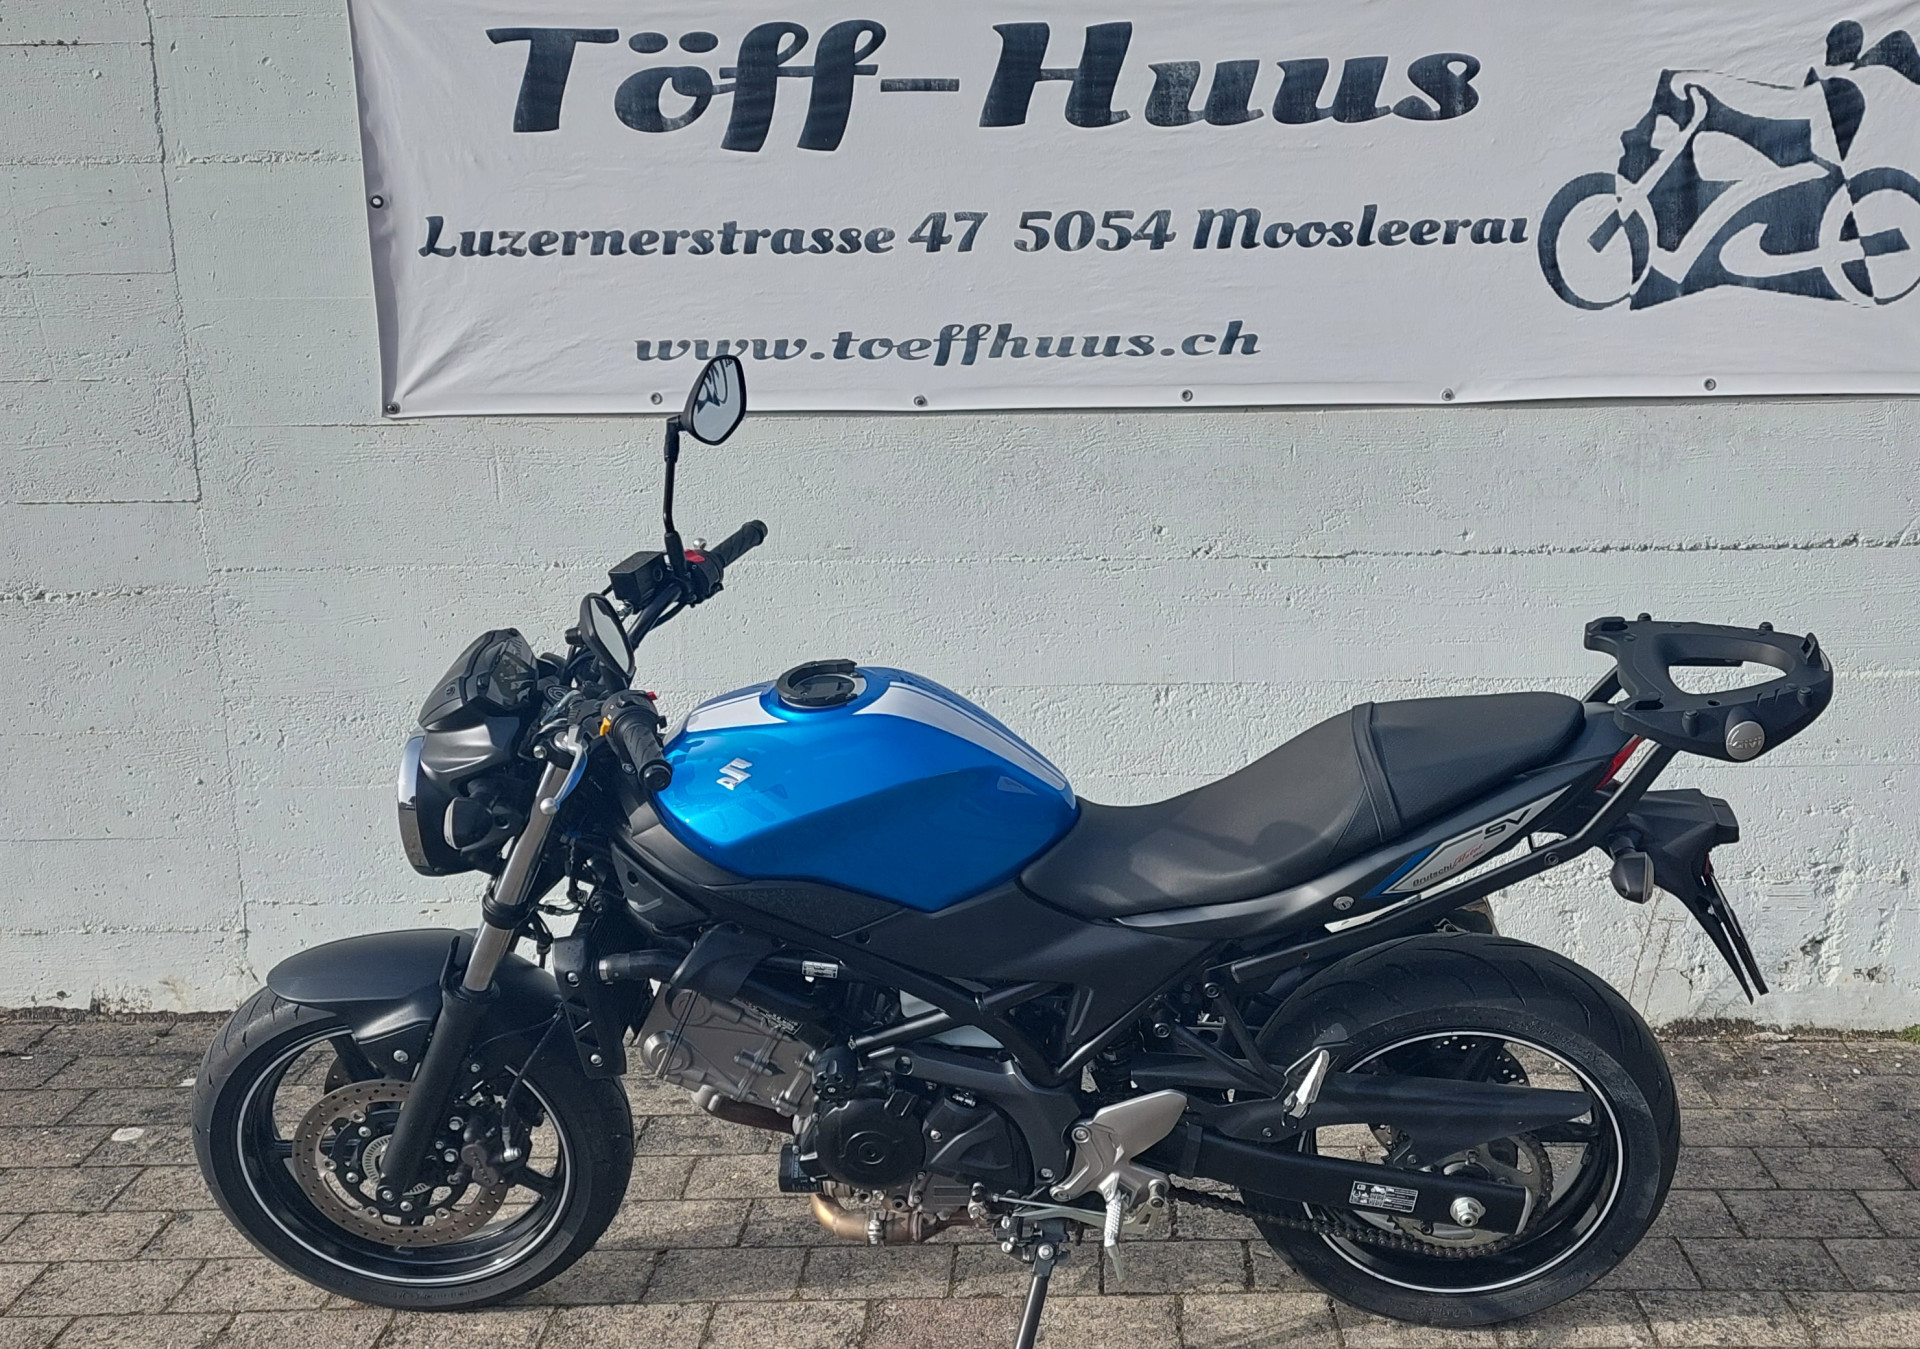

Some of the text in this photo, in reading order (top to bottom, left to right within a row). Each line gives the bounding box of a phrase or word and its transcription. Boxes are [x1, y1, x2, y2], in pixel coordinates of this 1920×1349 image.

[485, 19, 1481, 153] Töff-Huus
[418, 215, 896, 258] Luzernerstrasse
[907, 211, 988, 253] 47
[1013, 209, 1177, 253] 5054
[634, 320, 1262, 367] www.toeffhuus.ch
[1483, 807, 1532, 840] SV
